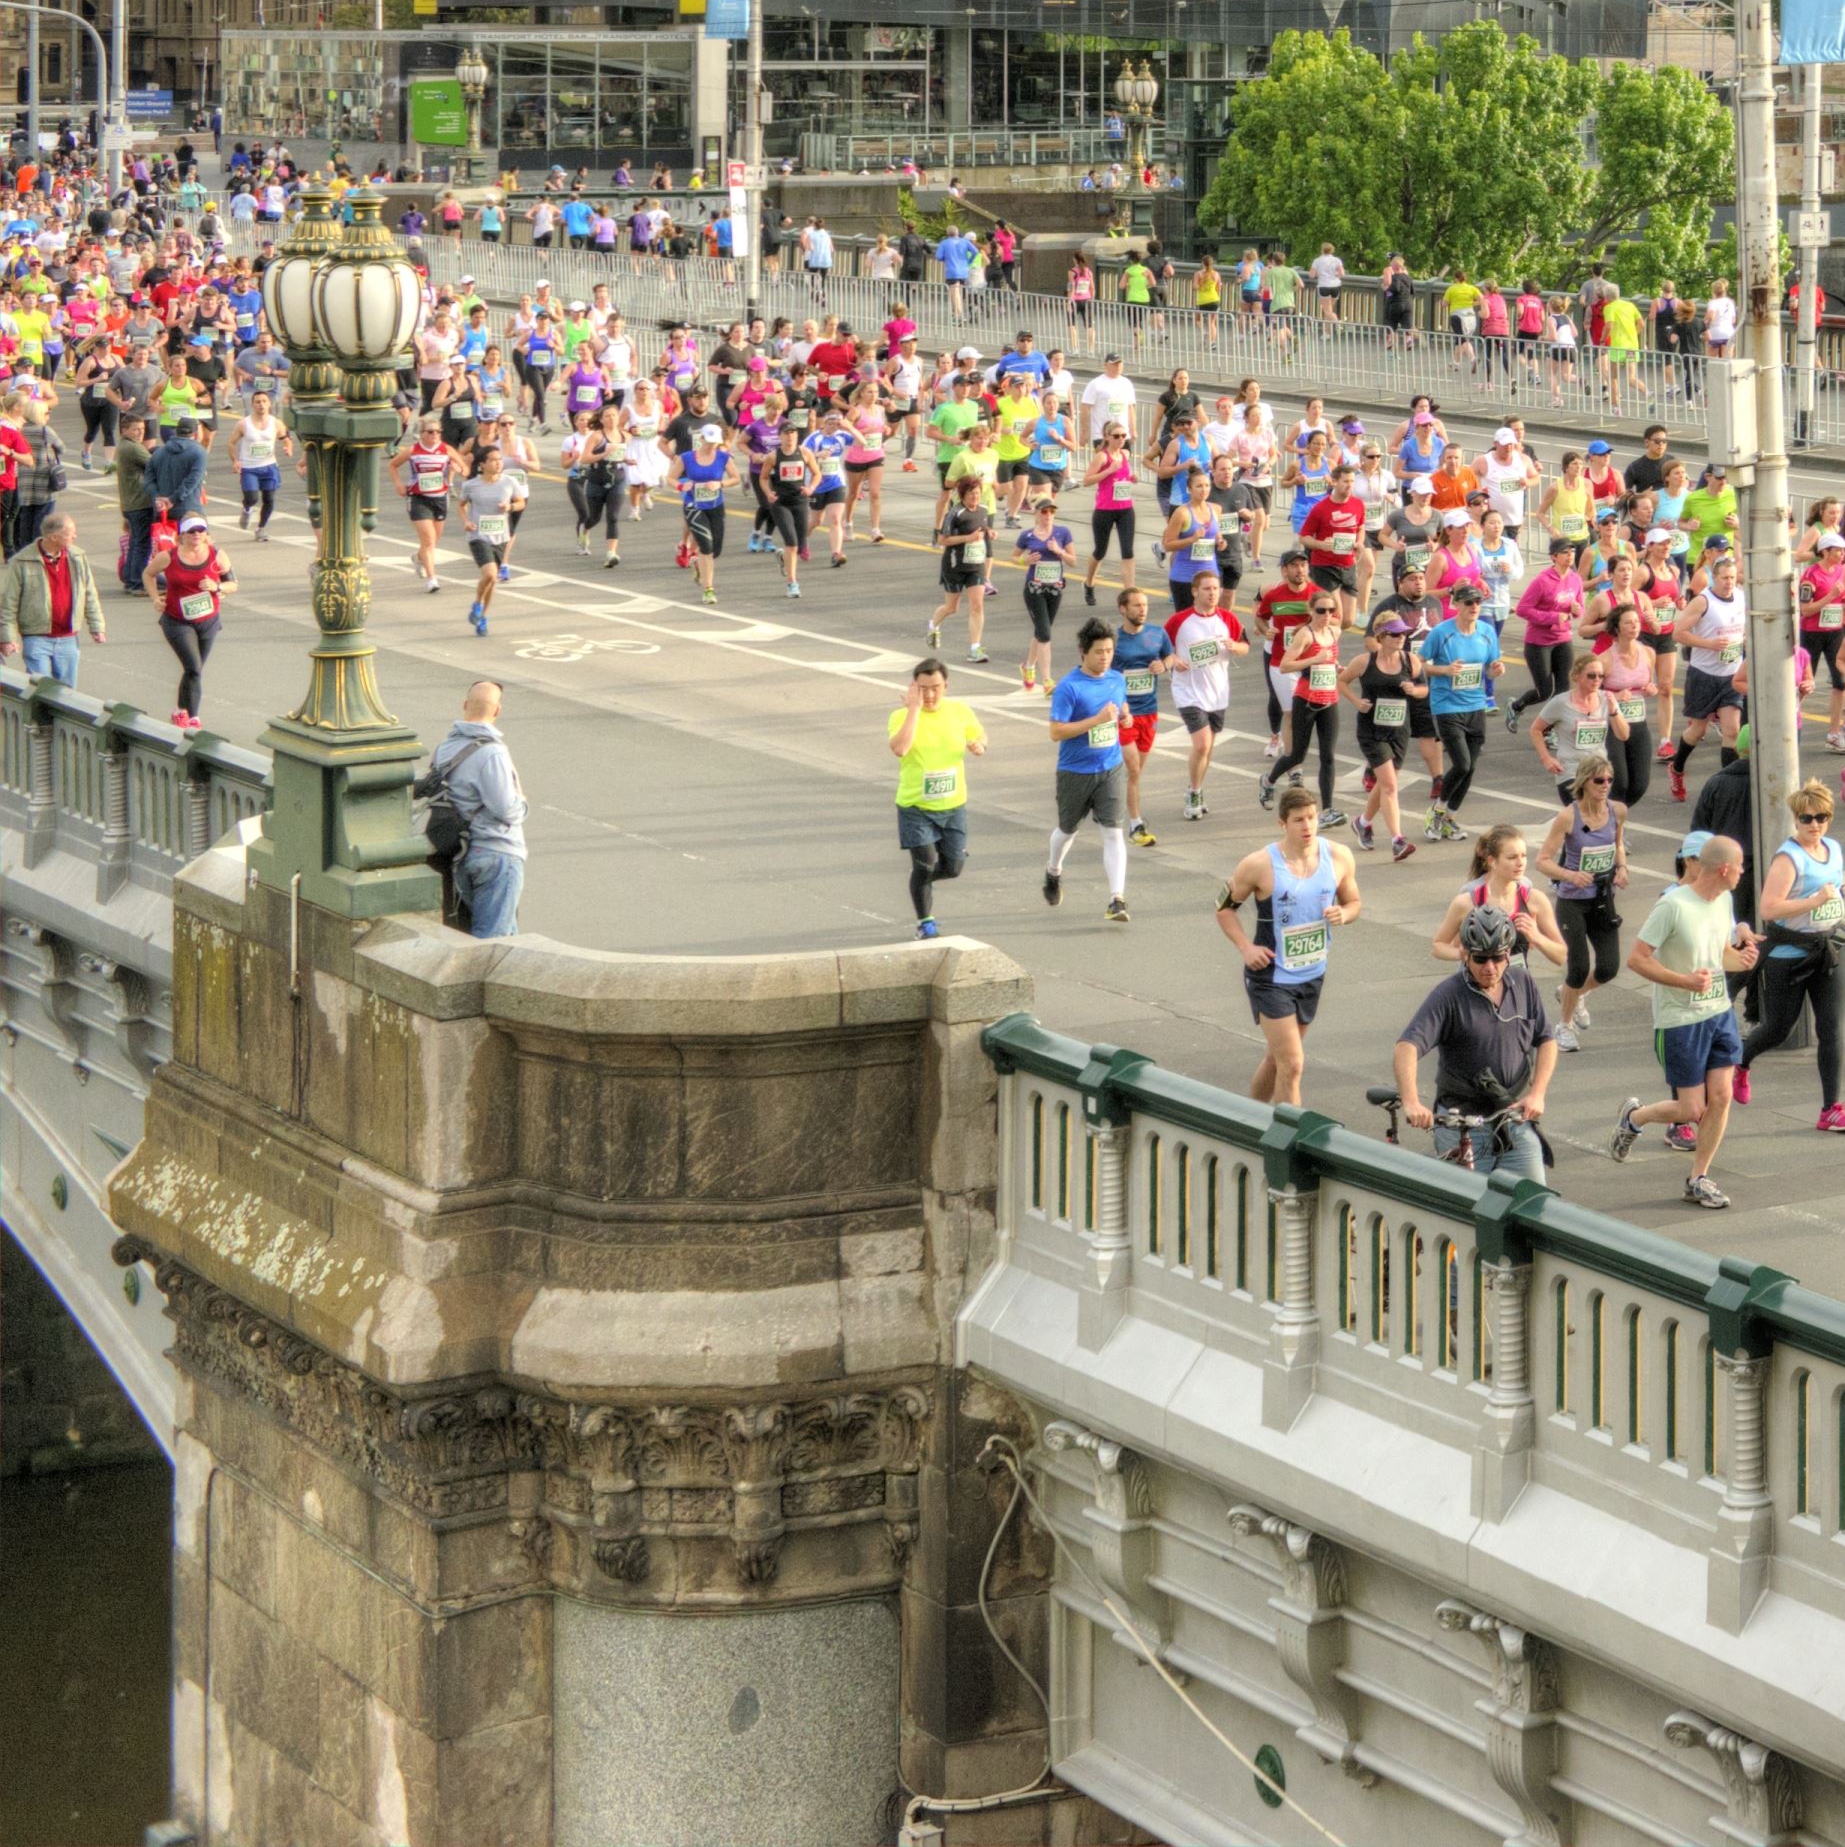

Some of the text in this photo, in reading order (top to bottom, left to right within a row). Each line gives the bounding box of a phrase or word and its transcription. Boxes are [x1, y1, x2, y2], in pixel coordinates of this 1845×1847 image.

[1191, 642, 1218, 662] 29929
[1127, 676, 1153, 690] 27522
[928, 777, 955, 794] 24911
[1287, 935, 1323, 955] 29764
